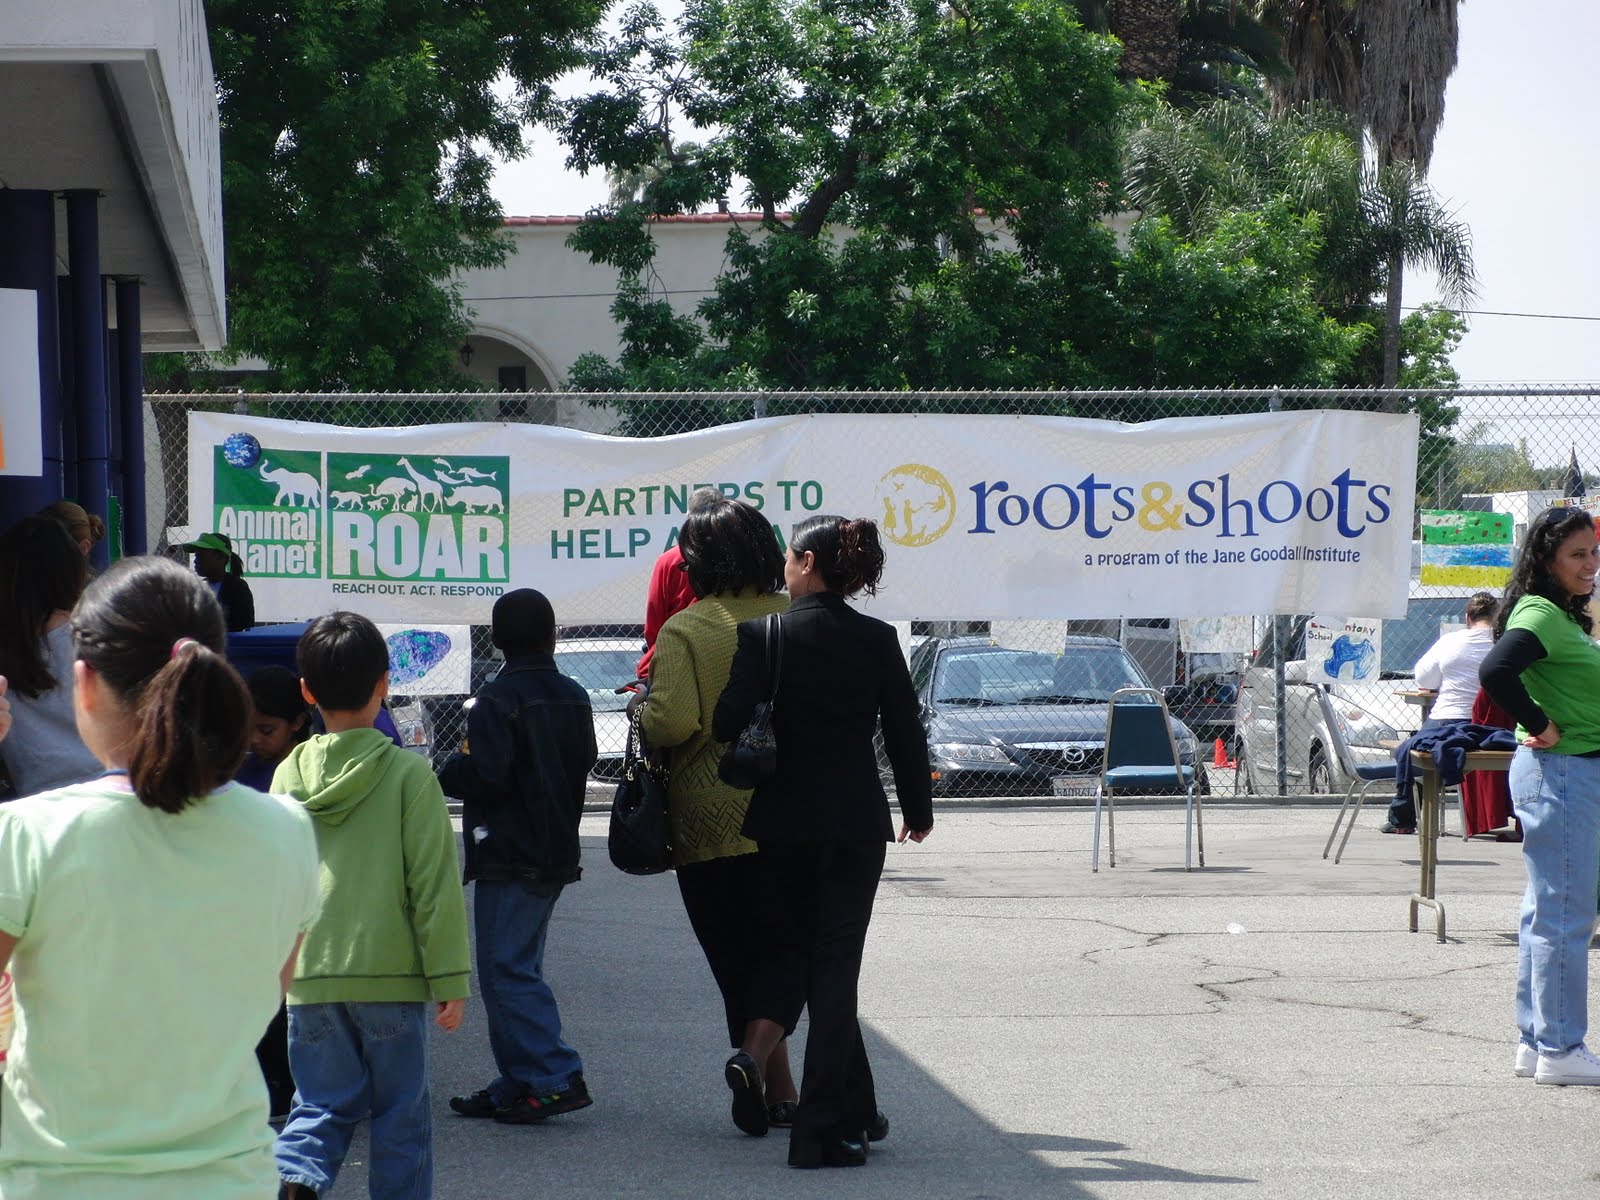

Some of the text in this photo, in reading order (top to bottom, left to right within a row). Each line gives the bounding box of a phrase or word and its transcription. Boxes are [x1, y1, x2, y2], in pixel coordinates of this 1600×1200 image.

[563, 480, 823, 517] PARTNRS TO
[968, 468, 1391, 538] roots&shoots
[218, 506, 316, 541] Animal
[332, 510, 506, 579] ROAR
[551, 528, 651, 560] HELP
[1085, 545, 1361, 566] a program of the Jane Goodall Institute
[332, 583, 504, 597] REACH OUT. ACT. RESPOND
